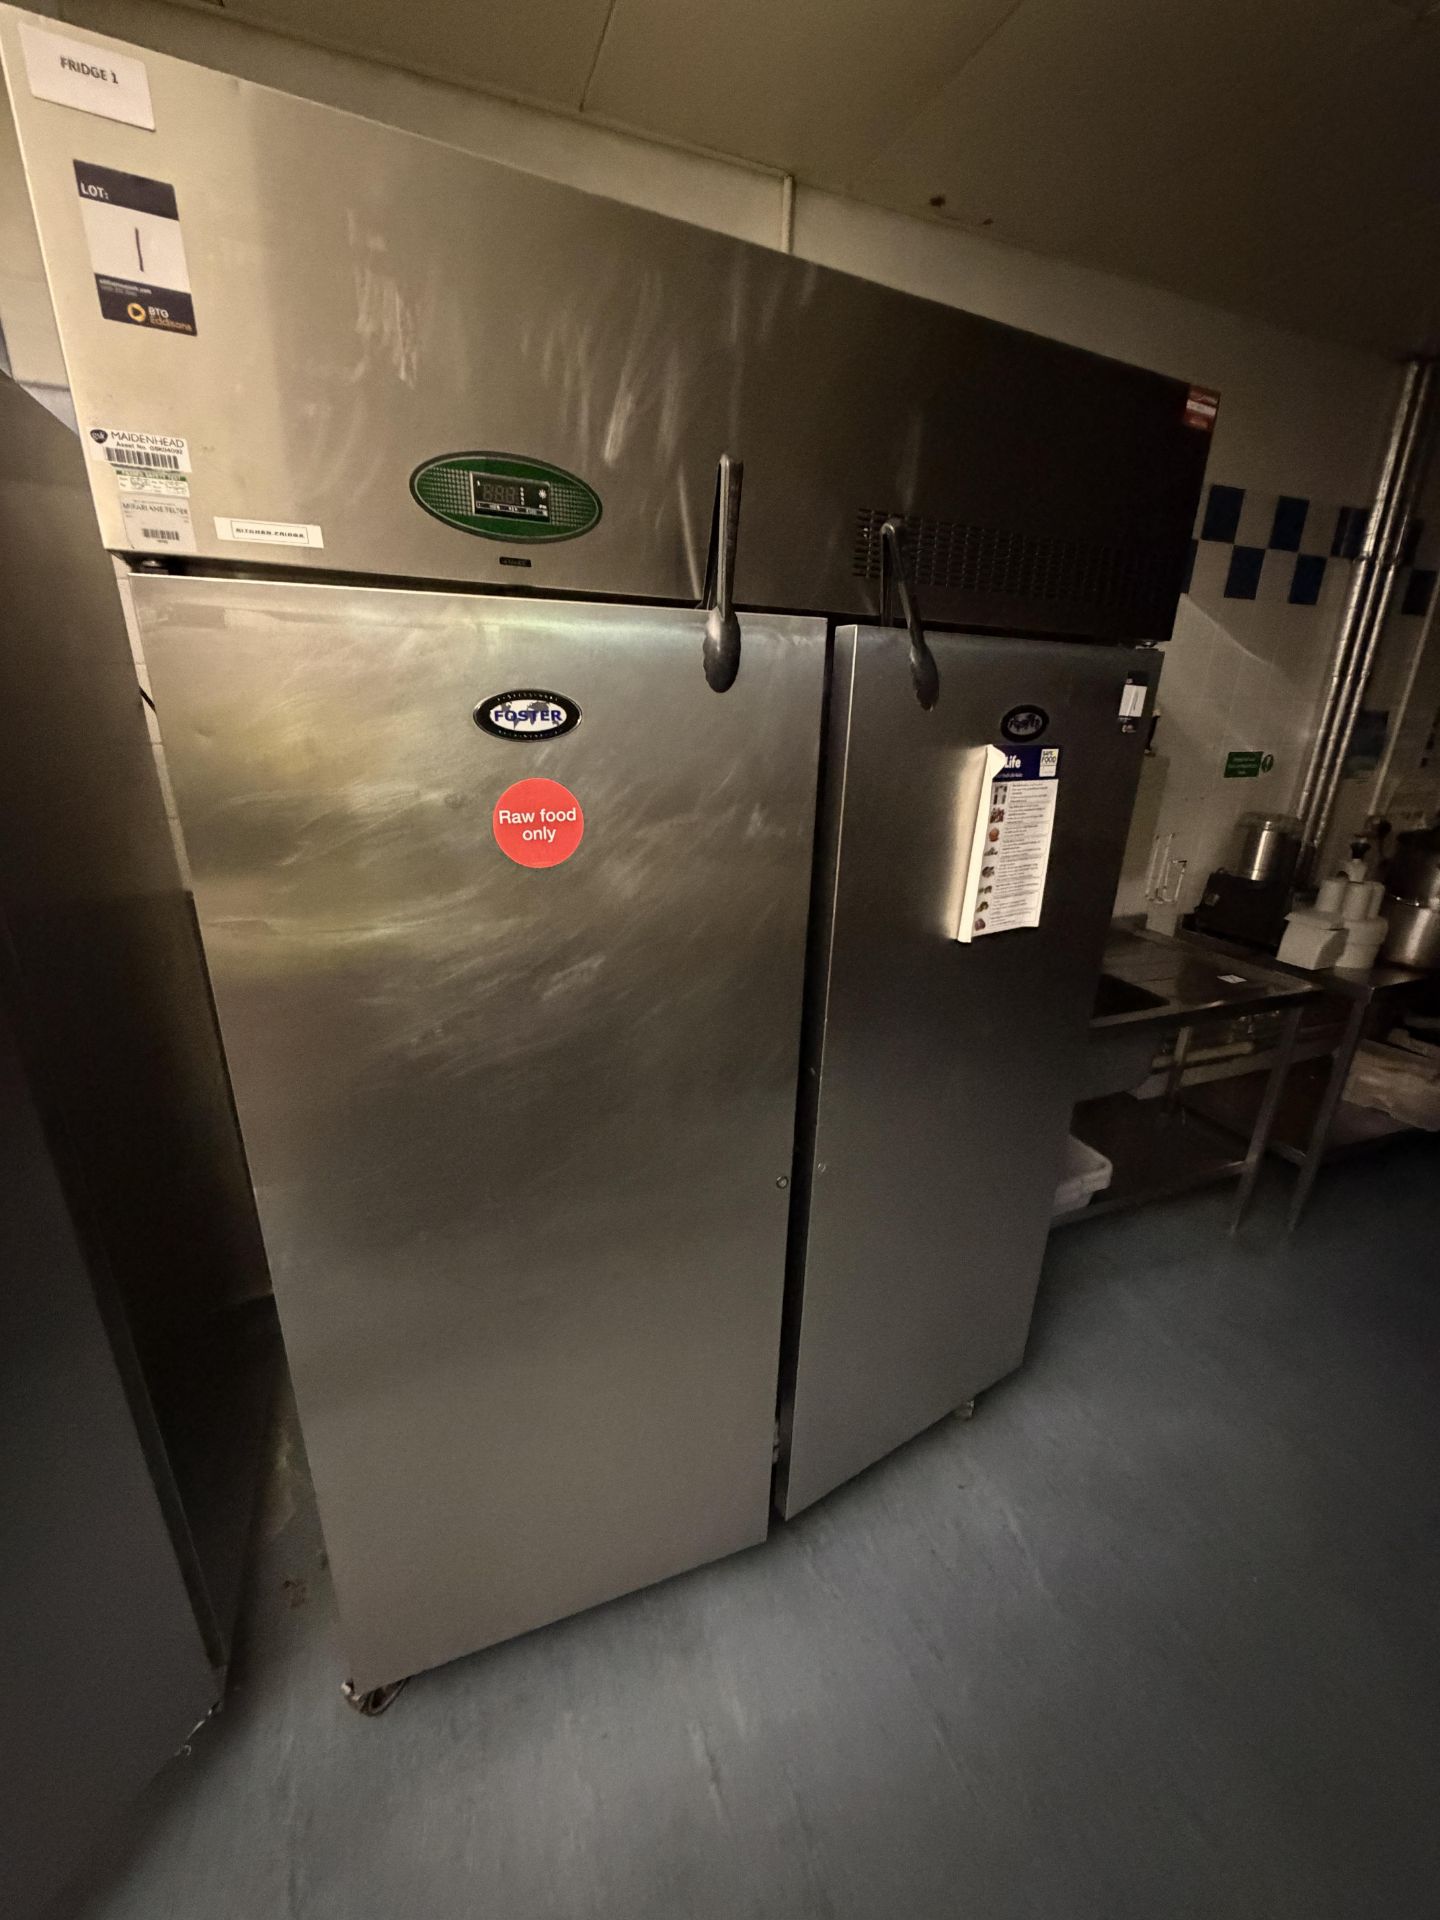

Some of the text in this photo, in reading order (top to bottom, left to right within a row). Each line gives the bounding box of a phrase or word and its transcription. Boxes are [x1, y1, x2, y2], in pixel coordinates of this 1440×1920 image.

[60, 56, 119, 84] FRIDGE 1
[80, 182, 109, 200] LOT:
[147, 306, 169, 319] BTG
[110, 431, 185, 448] MAIDENHEAD
[494, 710, 563, 722] FOSTER
[499, 808, 577, 825] Raw food
[522, 826, 556, 843] only
